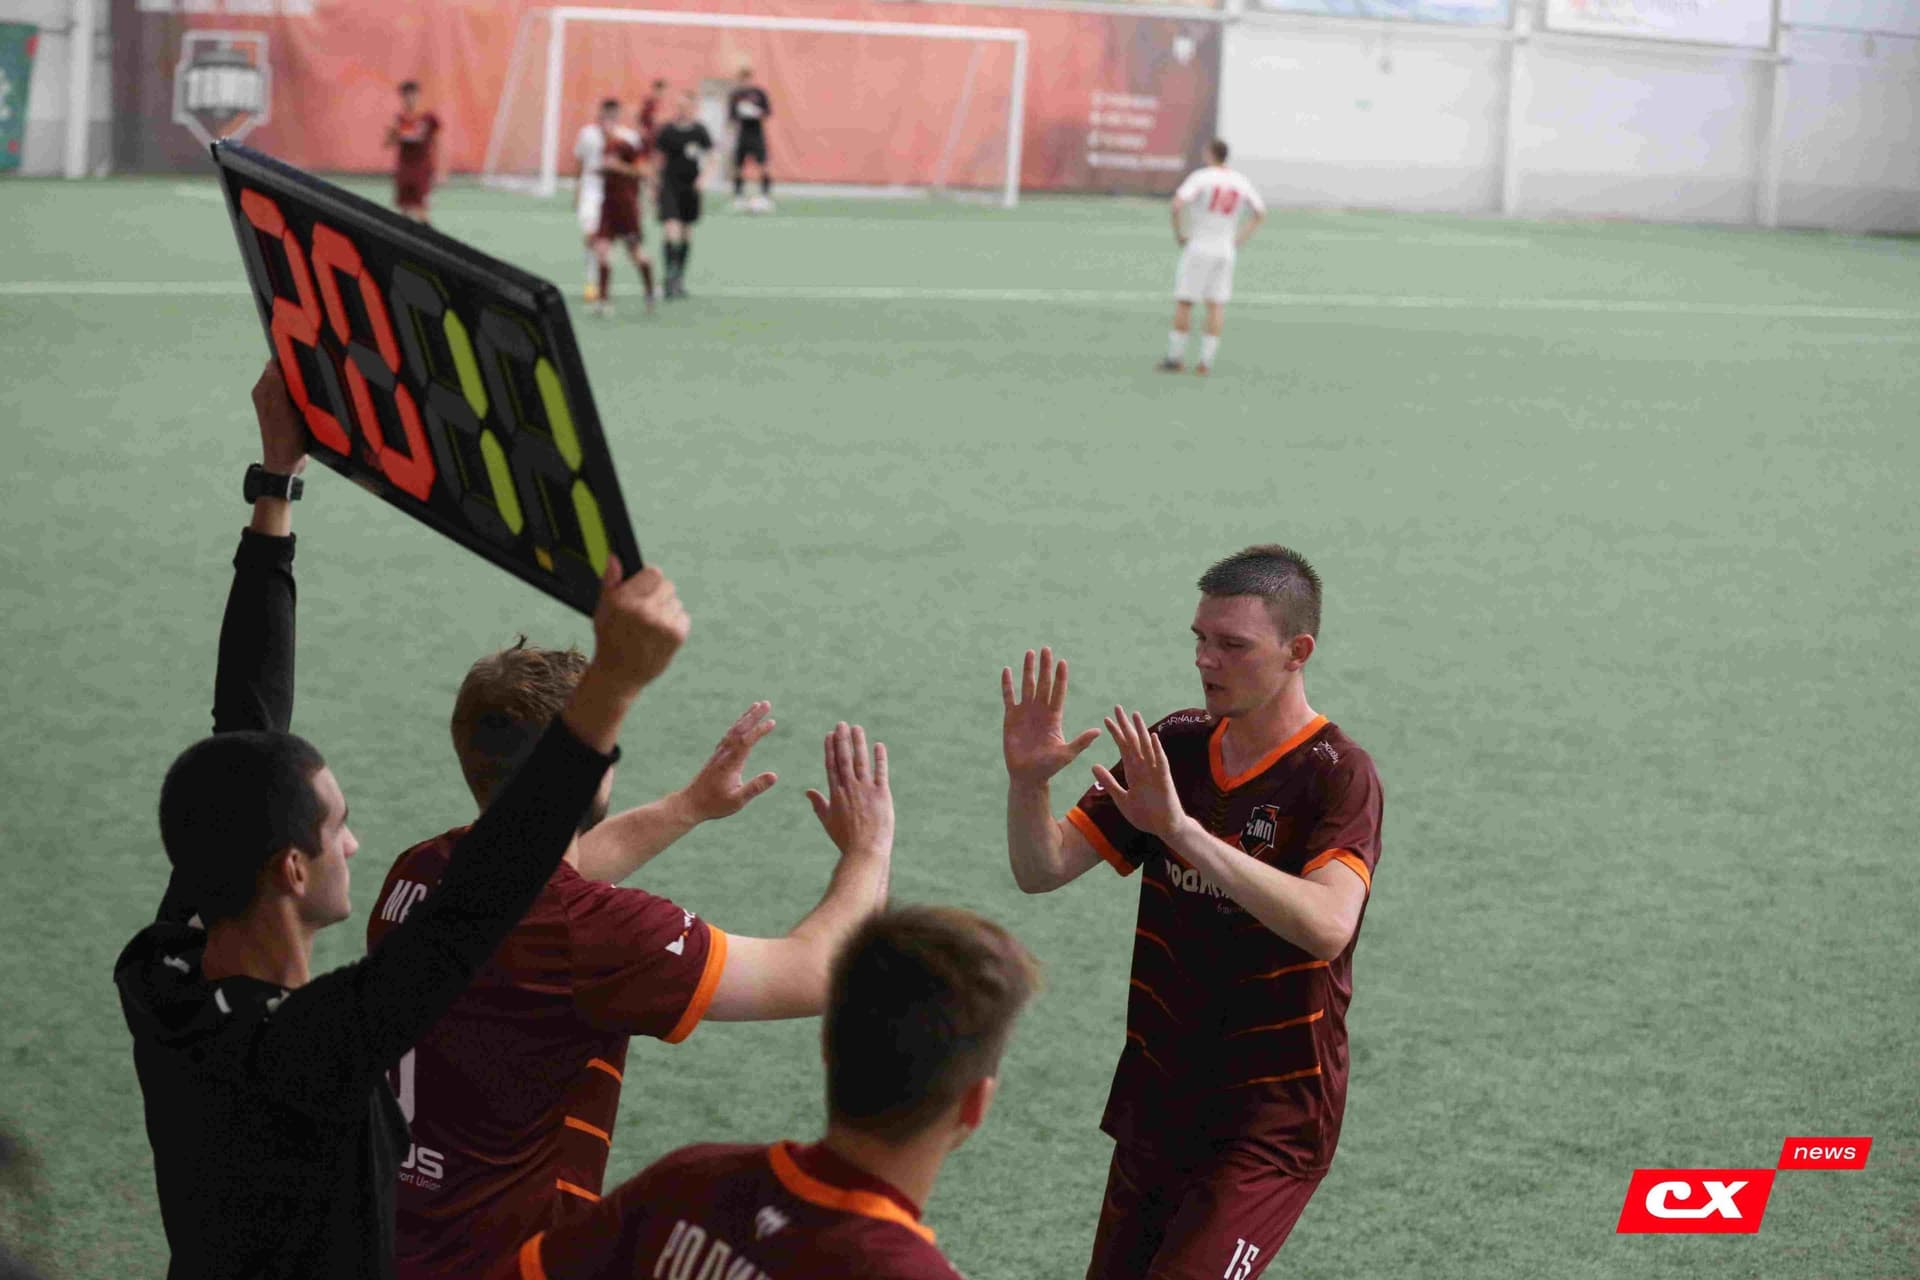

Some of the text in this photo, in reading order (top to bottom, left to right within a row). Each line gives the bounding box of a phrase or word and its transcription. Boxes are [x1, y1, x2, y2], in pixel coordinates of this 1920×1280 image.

[240, 187, 612, 578] 20 11
[1223, 1238, 1260, 1280] 15
